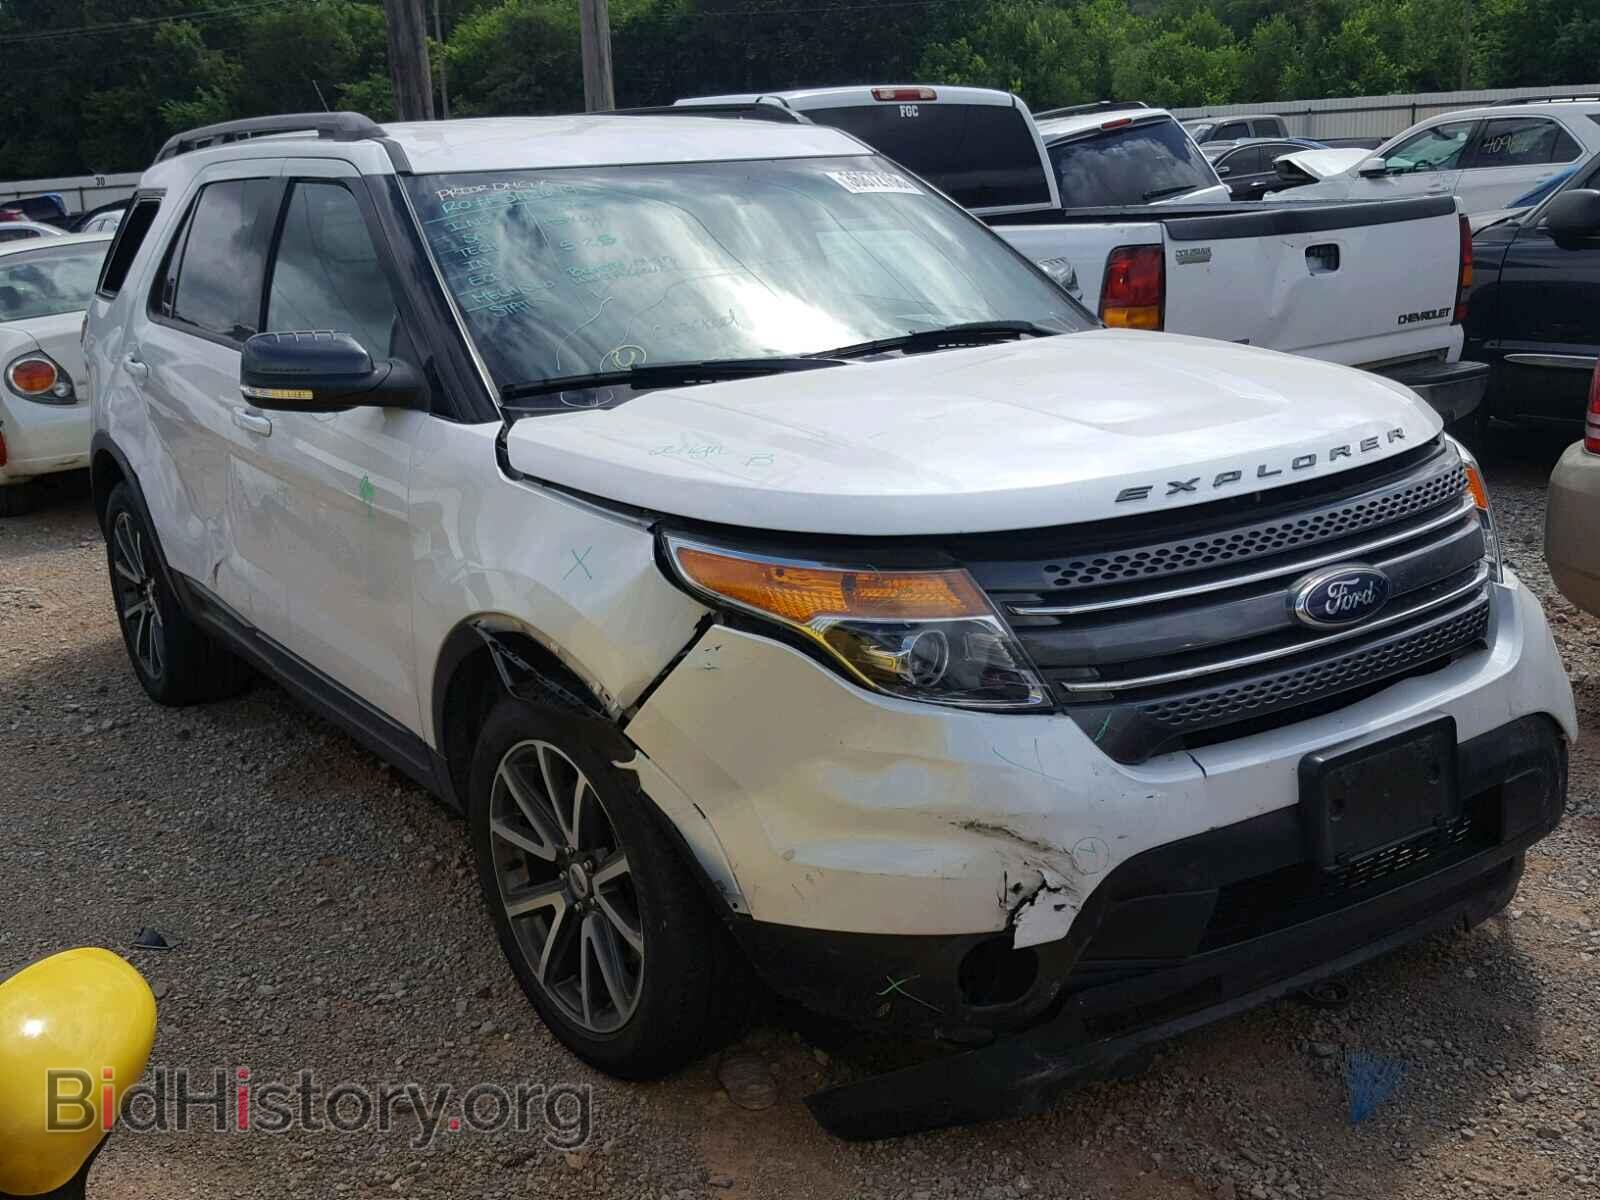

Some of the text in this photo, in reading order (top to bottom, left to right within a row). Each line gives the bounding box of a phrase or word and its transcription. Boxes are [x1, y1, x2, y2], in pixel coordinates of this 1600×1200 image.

[899, 104, 919, 118] FGC
[1397, 306, 1452, 325] CHEVROLET
[1114, 427, 1406, 503] EXPLORER
[1325, 577, 1376, 615] Ford
